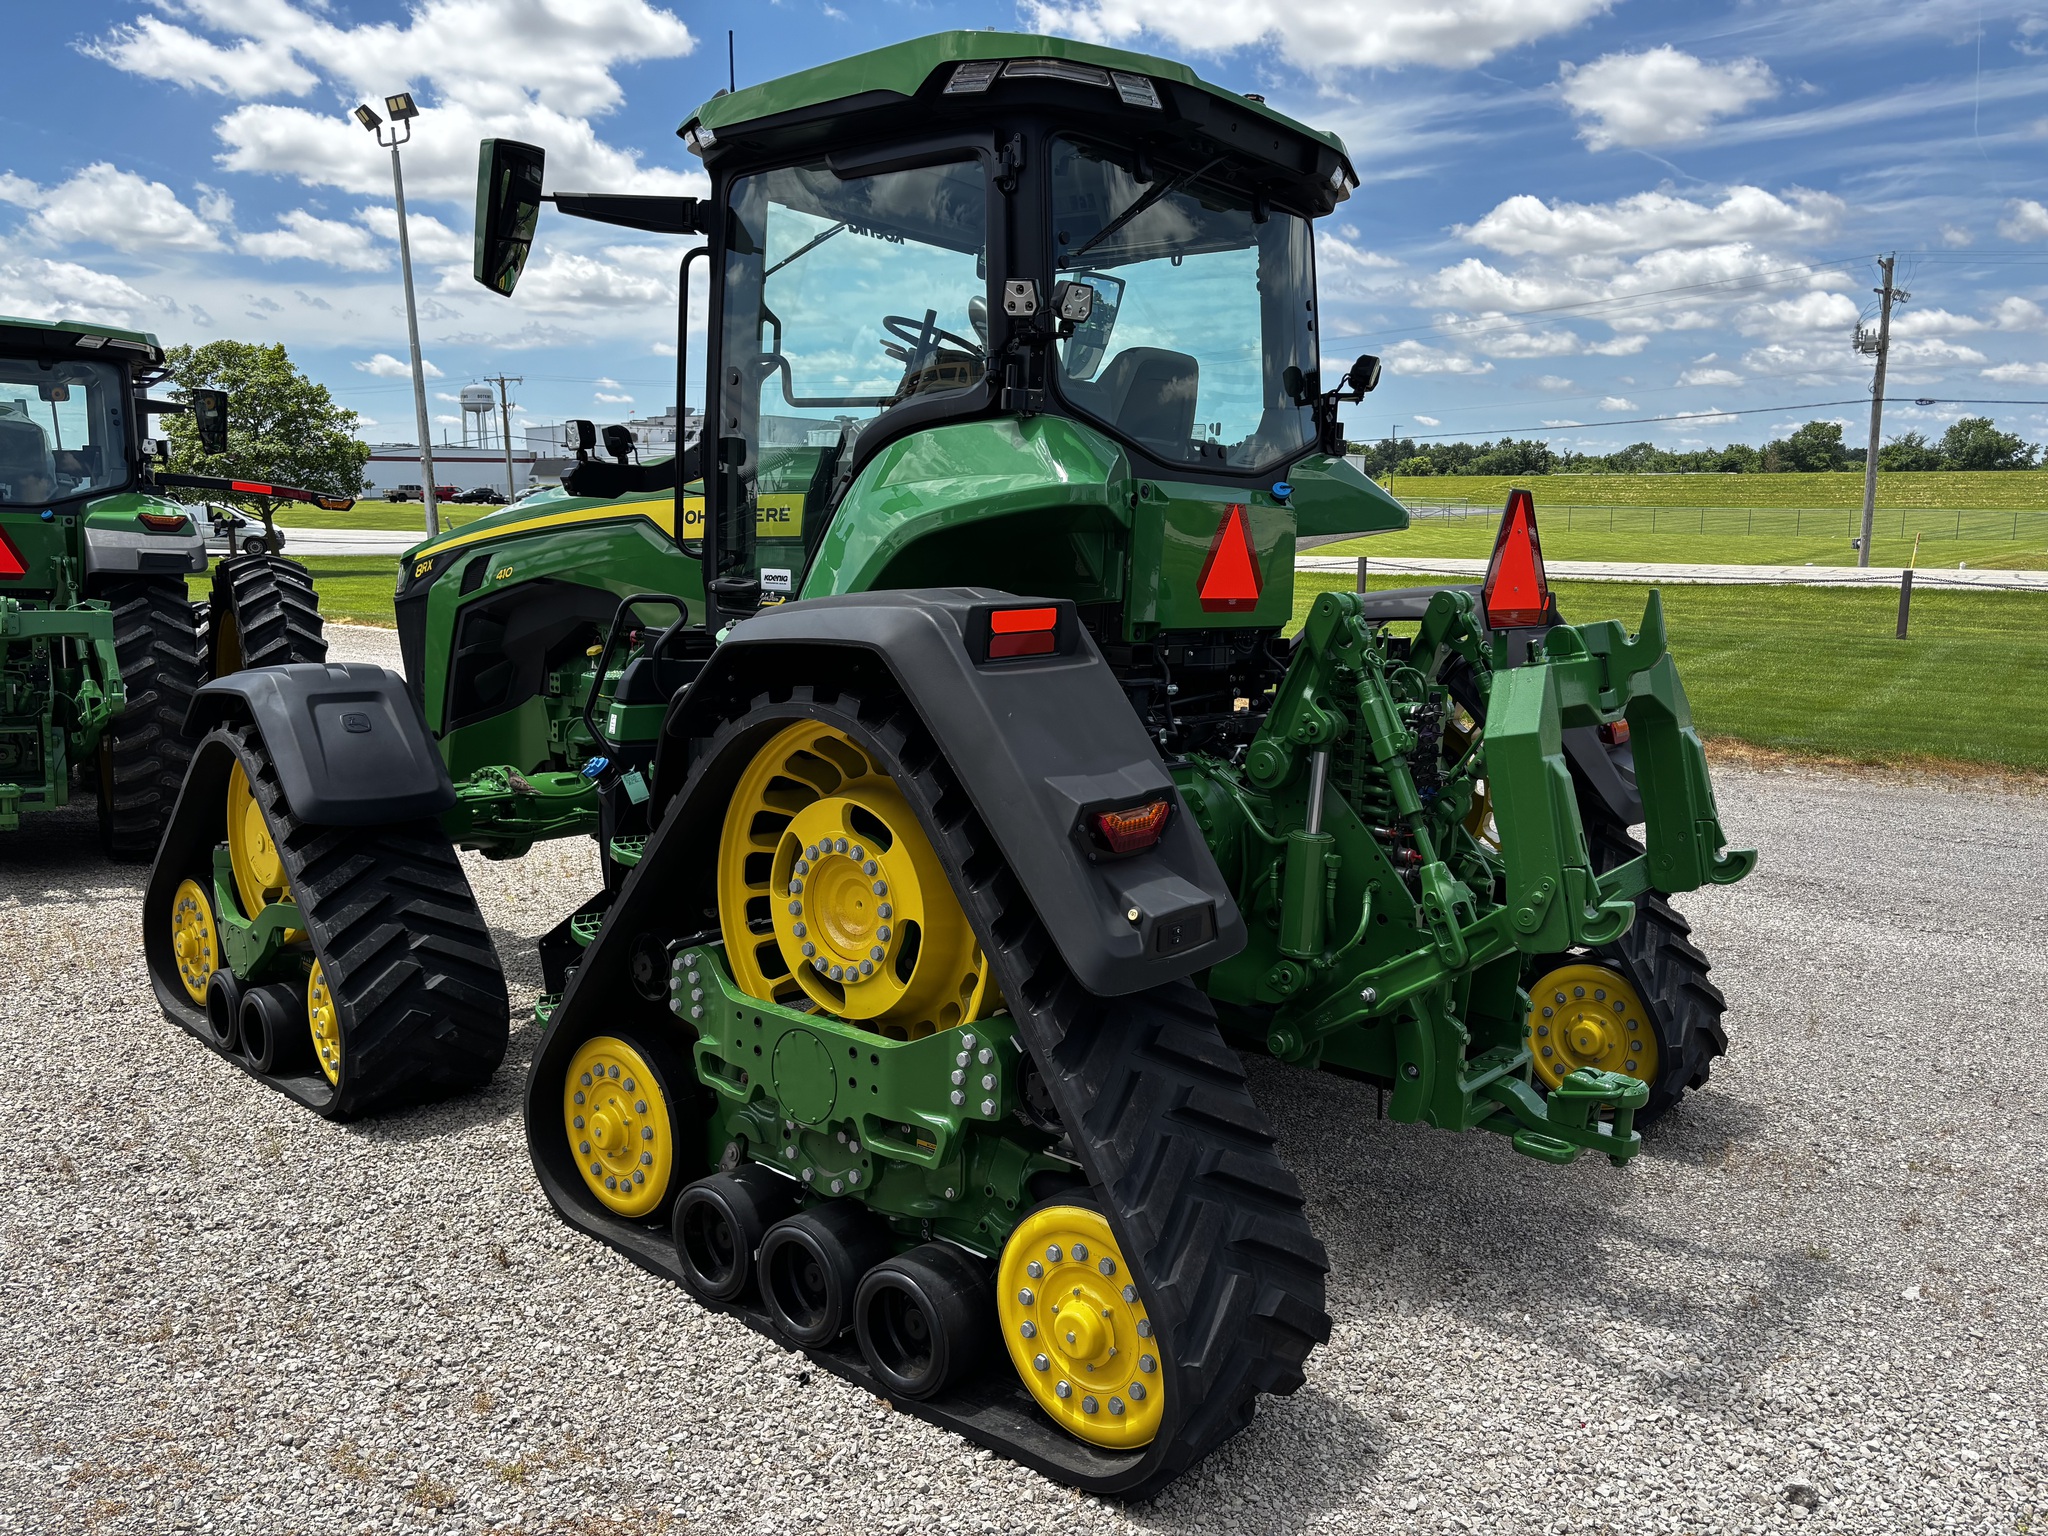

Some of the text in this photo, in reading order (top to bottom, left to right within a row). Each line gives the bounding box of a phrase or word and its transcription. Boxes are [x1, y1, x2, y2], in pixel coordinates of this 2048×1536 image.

[756, 508, 791, 522] ERE
[415, 559, 433, 578] 8RX
[496, 567, 513, 580] 410
